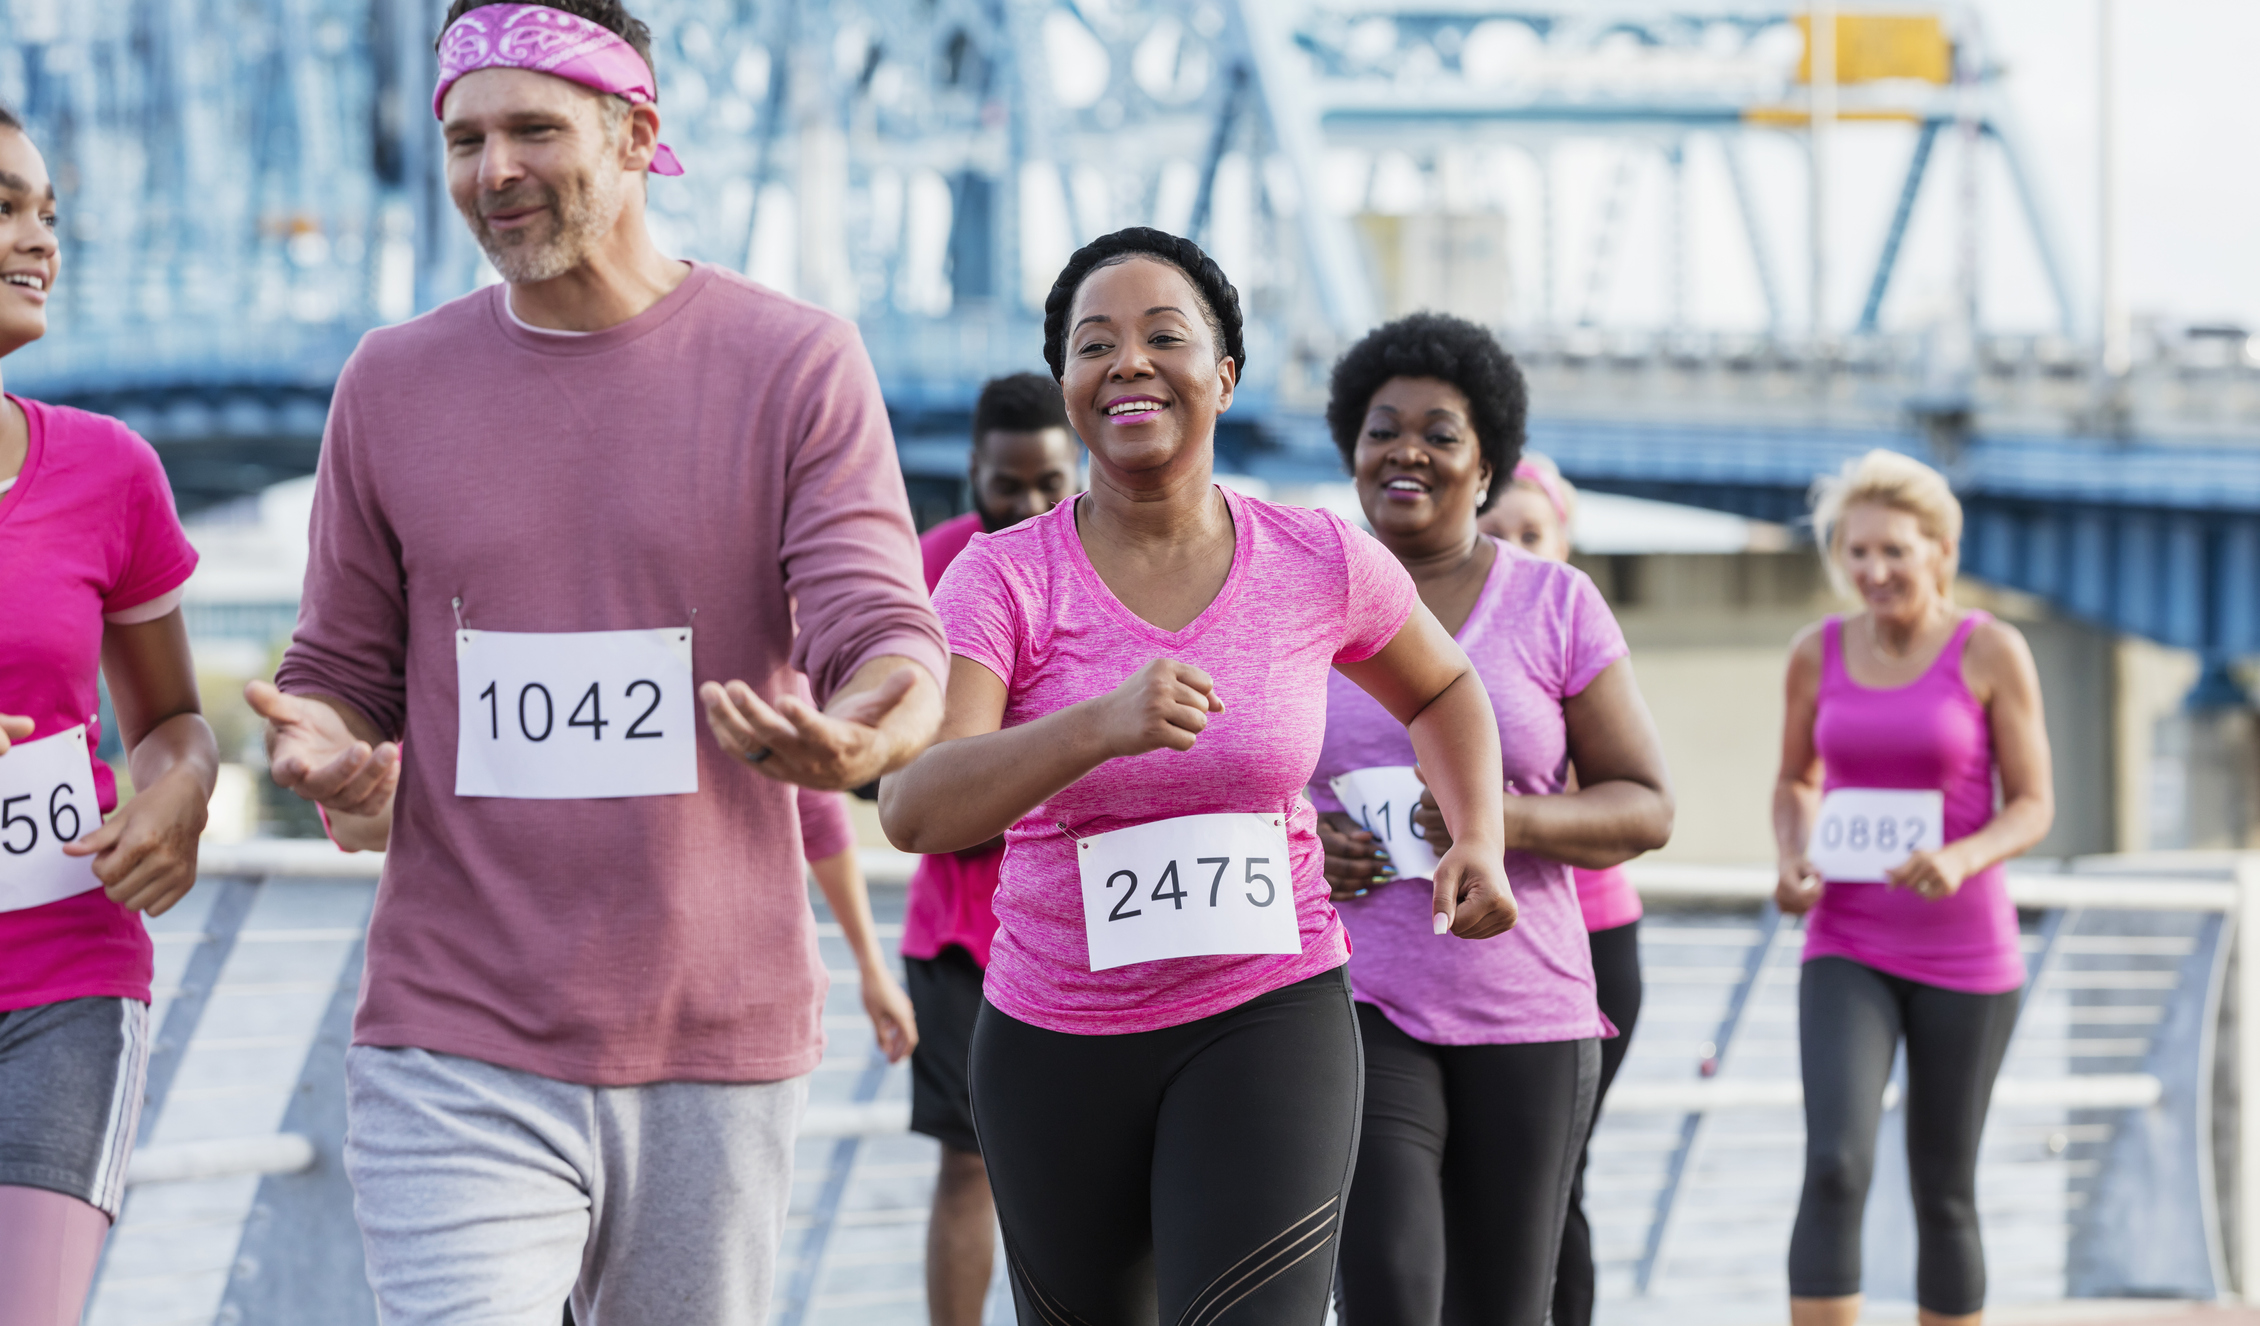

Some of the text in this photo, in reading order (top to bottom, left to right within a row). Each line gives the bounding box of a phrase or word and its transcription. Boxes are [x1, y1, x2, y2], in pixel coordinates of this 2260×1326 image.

[480, 680, 663, 742] 1042
[1, 783, 80, 855] 56
[1821, 815, 1926, 853] 0882
[1106, 857, 1275, 922] 2475
